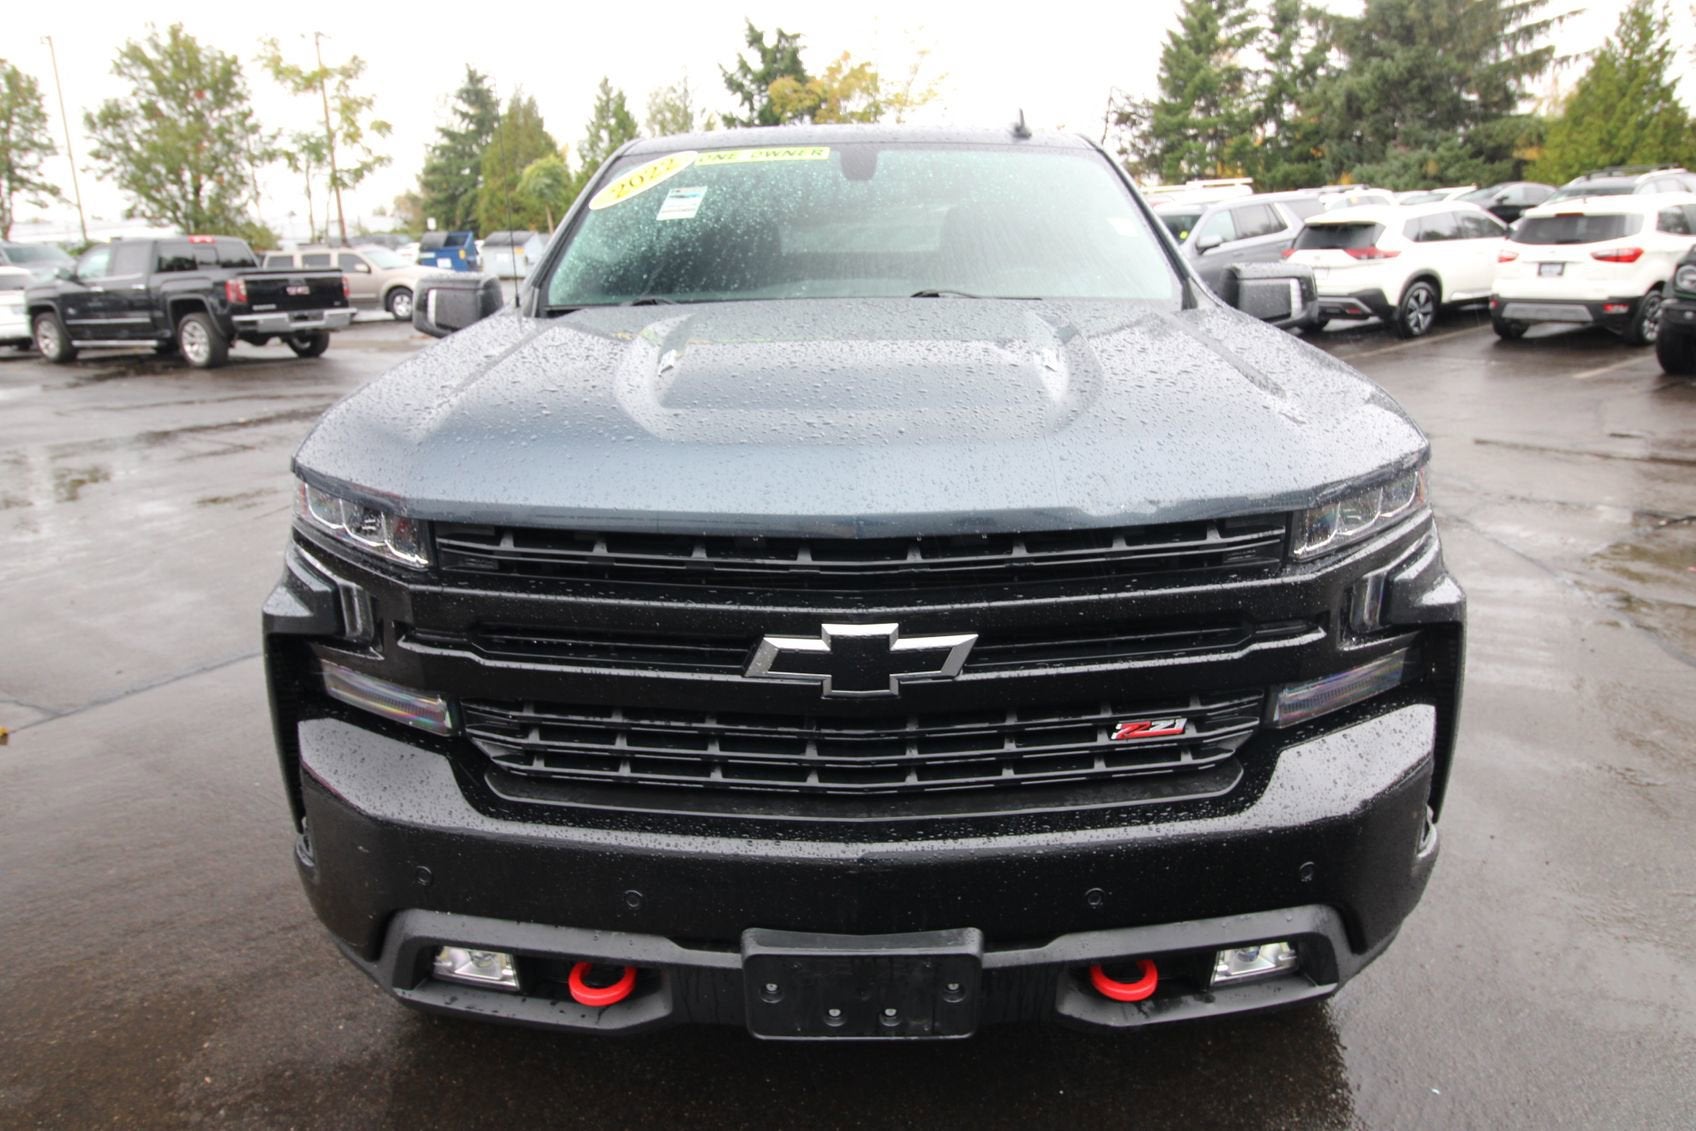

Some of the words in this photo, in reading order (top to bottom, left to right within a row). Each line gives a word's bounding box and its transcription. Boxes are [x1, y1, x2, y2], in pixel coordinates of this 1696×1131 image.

[699, 153, 737, 163] ONE
[751, 149, 824, 159] OWNER
[1111, 718, 1187, 740] Z71
